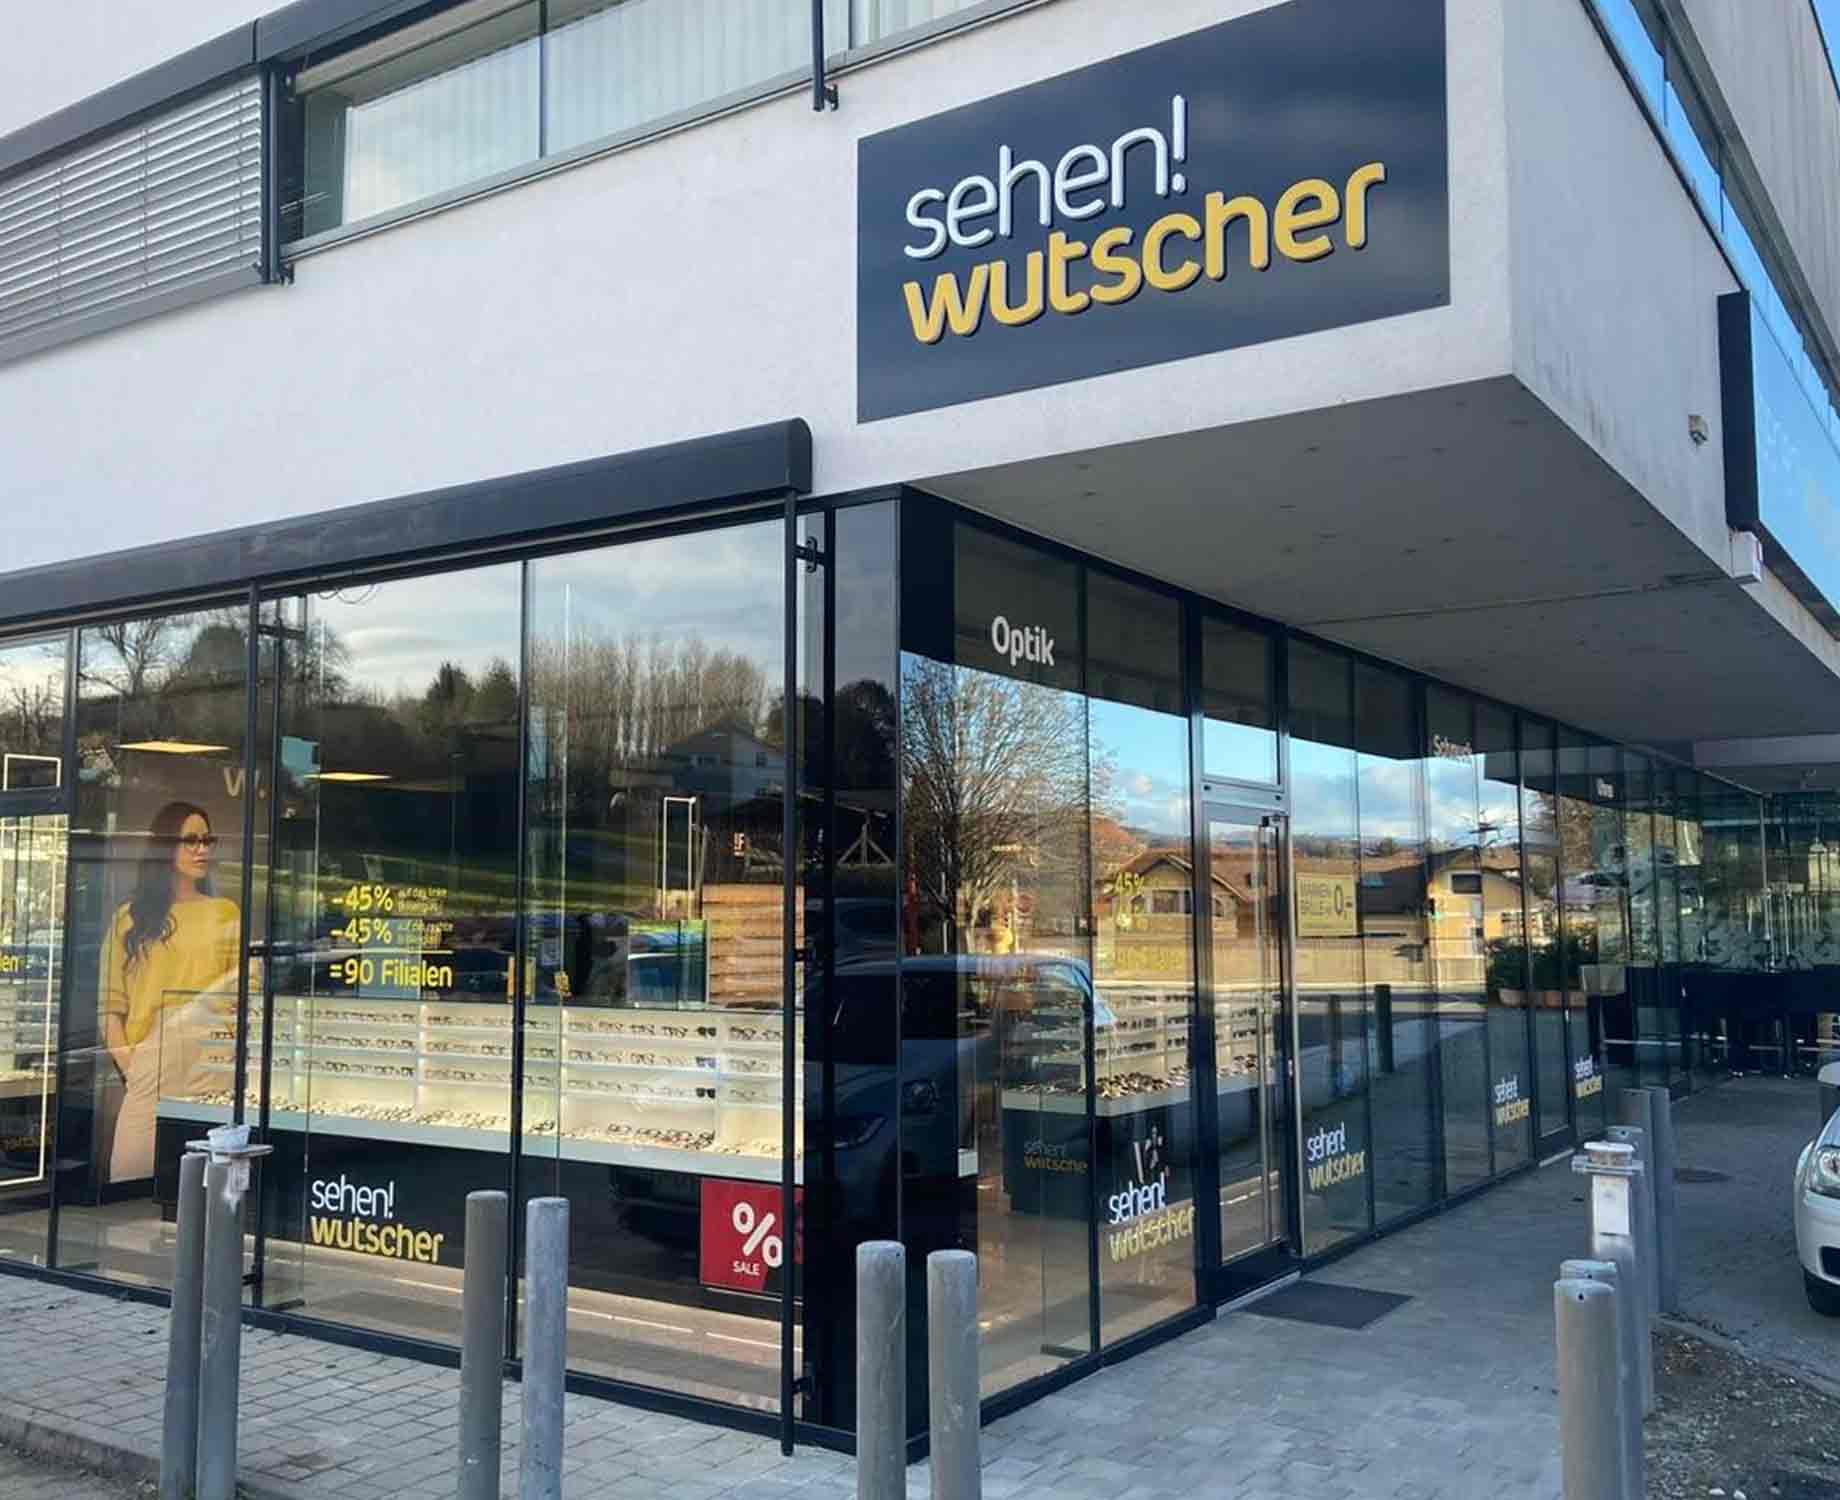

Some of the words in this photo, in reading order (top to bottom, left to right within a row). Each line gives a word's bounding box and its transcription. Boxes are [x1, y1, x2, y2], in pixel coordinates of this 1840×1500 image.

[904, 94, 1187, 259] sehen!
[903, 160, 1386, 345] wutscher
[991, 615, 1055, 667] Optik
[331, 884, 394, 912] -45%
[329, 917, 393, 944] -45%
[329, 957, 375, 985] =90
[381, 959, 453, 988] Filialen
[310, 1173, 395, 1219] sehen!
[1108, 1170, 1167, 1225] sehen!
[310, 1215, 445, 1264] wutscher
[1108, 1205, 1196, 1264] wutscher
[732, 1260, 761, 1277] SALE
